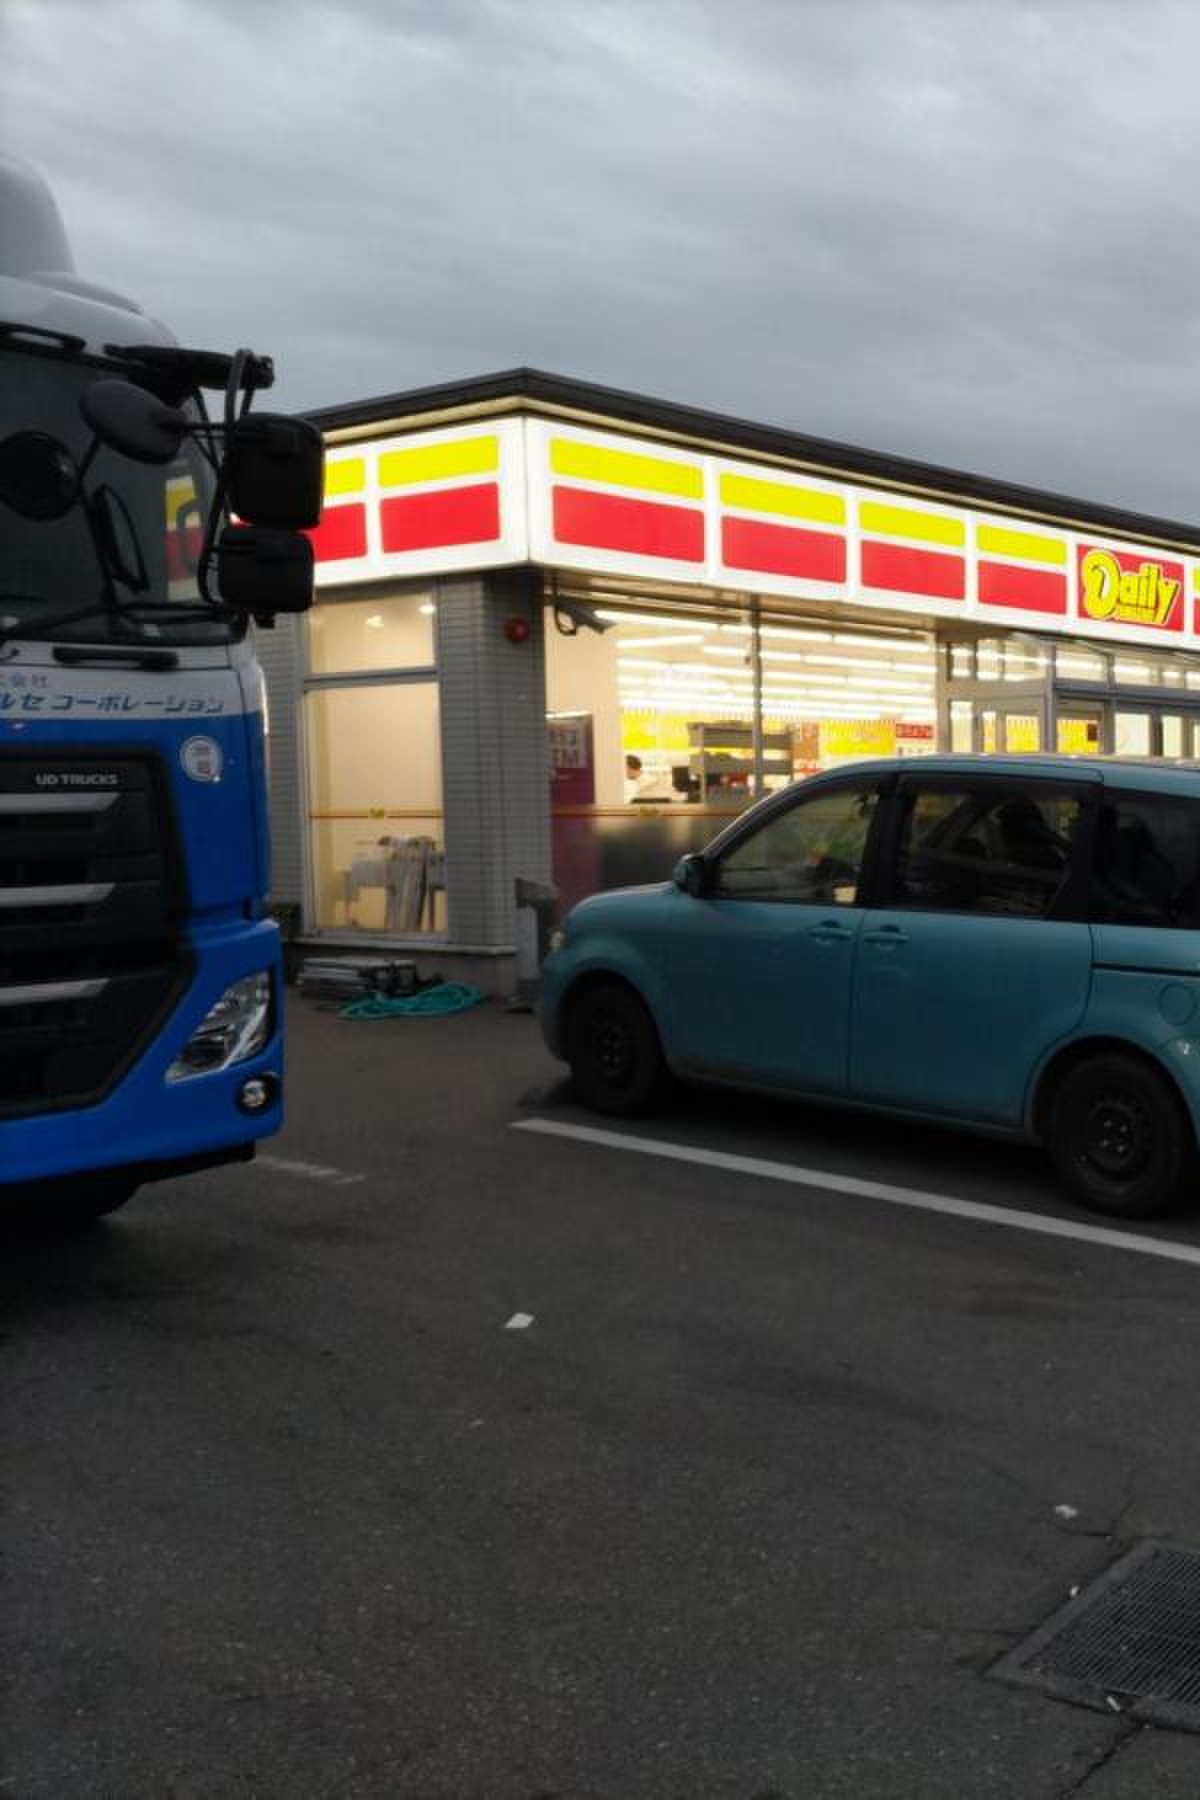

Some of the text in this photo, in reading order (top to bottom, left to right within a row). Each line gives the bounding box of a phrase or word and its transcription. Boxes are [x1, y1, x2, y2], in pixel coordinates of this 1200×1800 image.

[1083, 550, 1180, 625] Daily
[36, 774, 119, 785] UD TRUCKS
